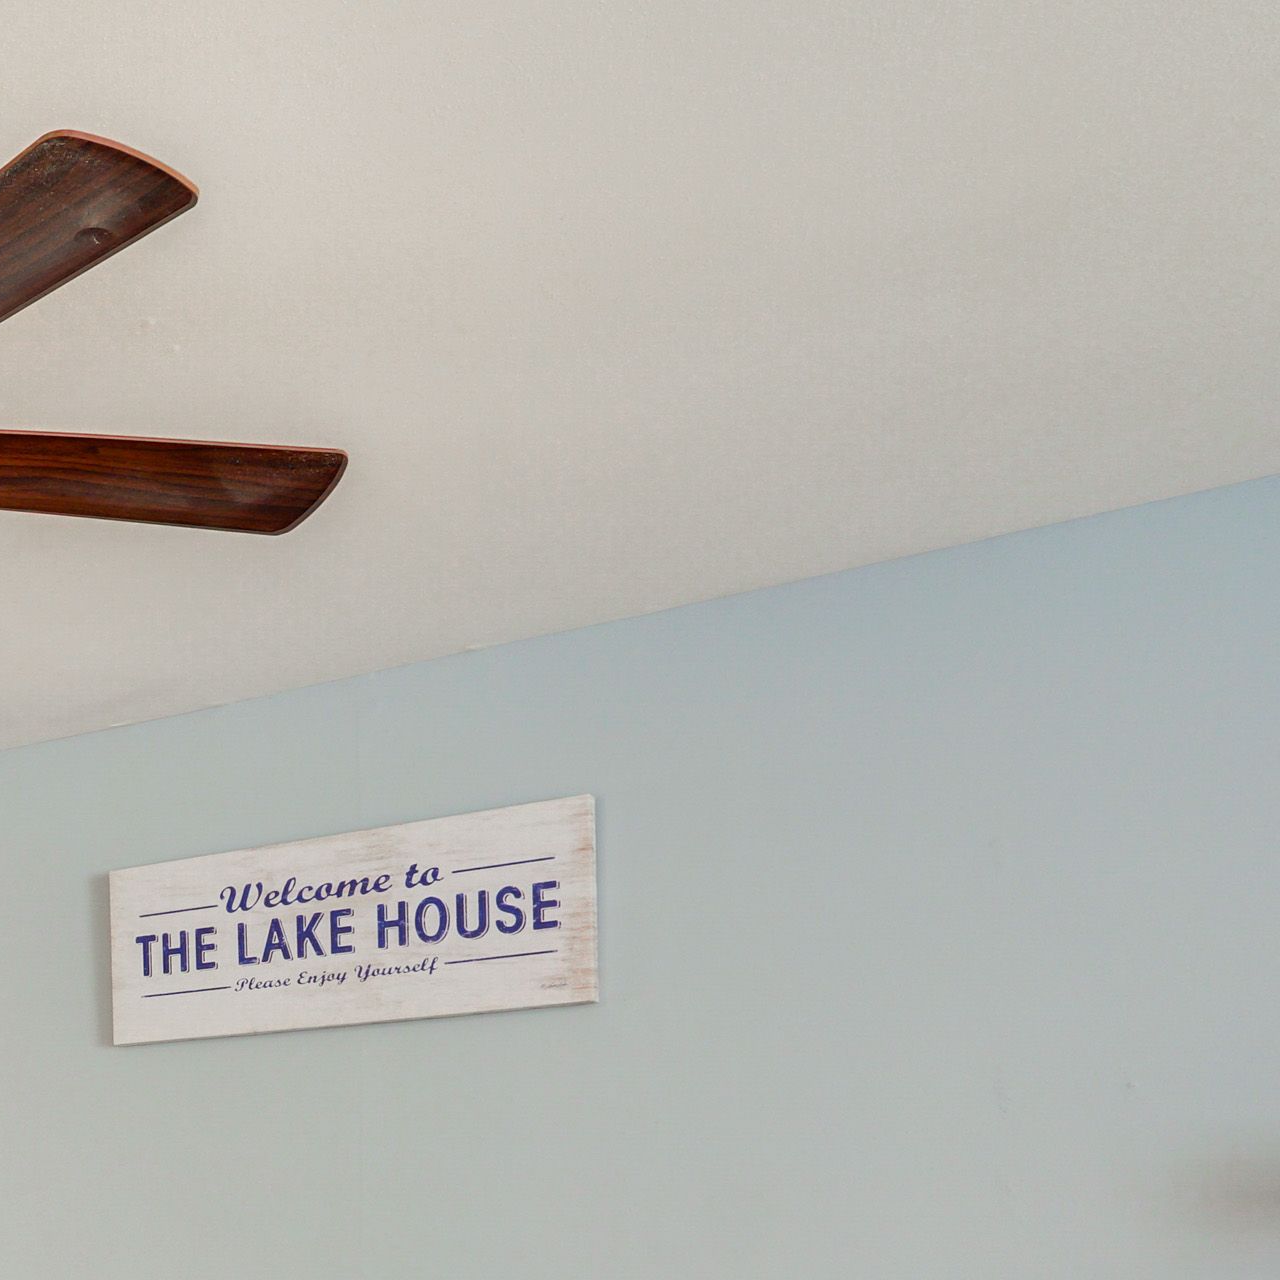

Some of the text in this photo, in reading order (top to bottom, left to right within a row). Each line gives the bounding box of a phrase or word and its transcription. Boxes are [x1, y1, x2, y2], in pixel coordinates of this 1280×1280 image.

[221, 863, 444, 914] Welcome to
[136, 880, 561, 978] THE LAKE HOUSE
[234, 956, 439, 993] Please Enjoy Yourself
